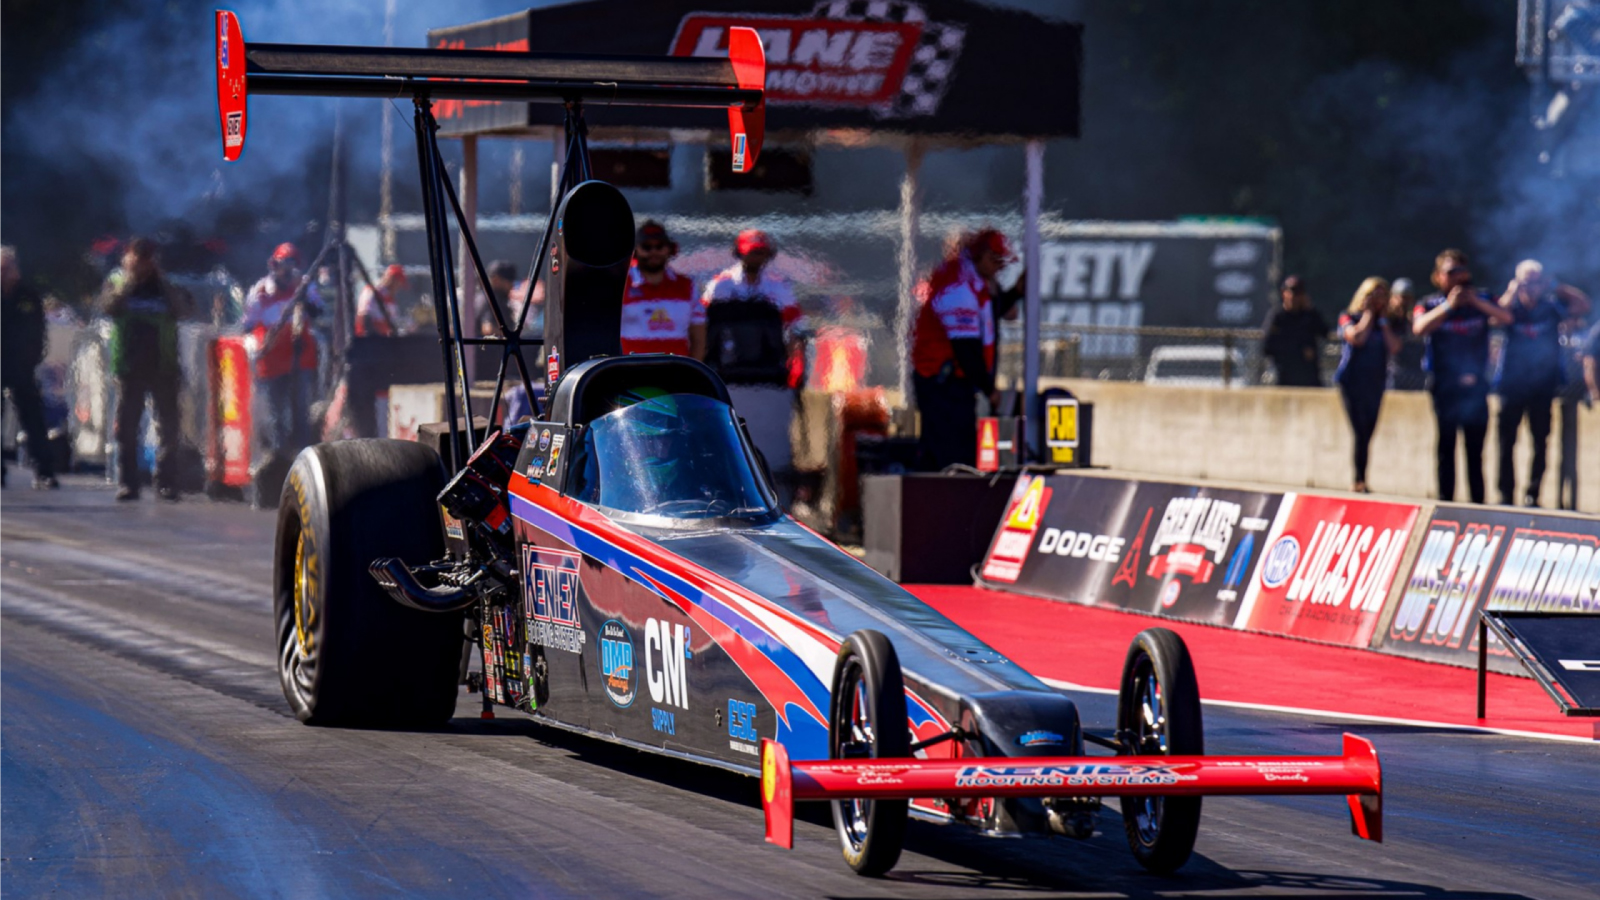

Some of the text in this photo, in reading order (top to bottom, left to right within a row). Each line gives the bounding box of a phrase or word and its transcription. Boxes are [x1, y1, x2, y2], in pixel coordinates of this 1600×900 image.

[1039, 241, 1155, 299] FETY
[1038, 527, 1126, 563] DODGE
[1285, 520, 1408, 613] LUCAS OIL
[1393, 528, 1502, 640] US-131
[1339, 613, 1375, 628] SERI
[601, 638, 633, 680] DMP
[652, 706, 676, 736] SUPPLY
[728, 698, 758, 743] ESC
[856, 776, 903, 785] Calvin
[956, 774, 1062, 787] ROOFING
[1067, 774, 1178, 785] SYSTEMS
[1263, 772, 1310, 783] Brady
